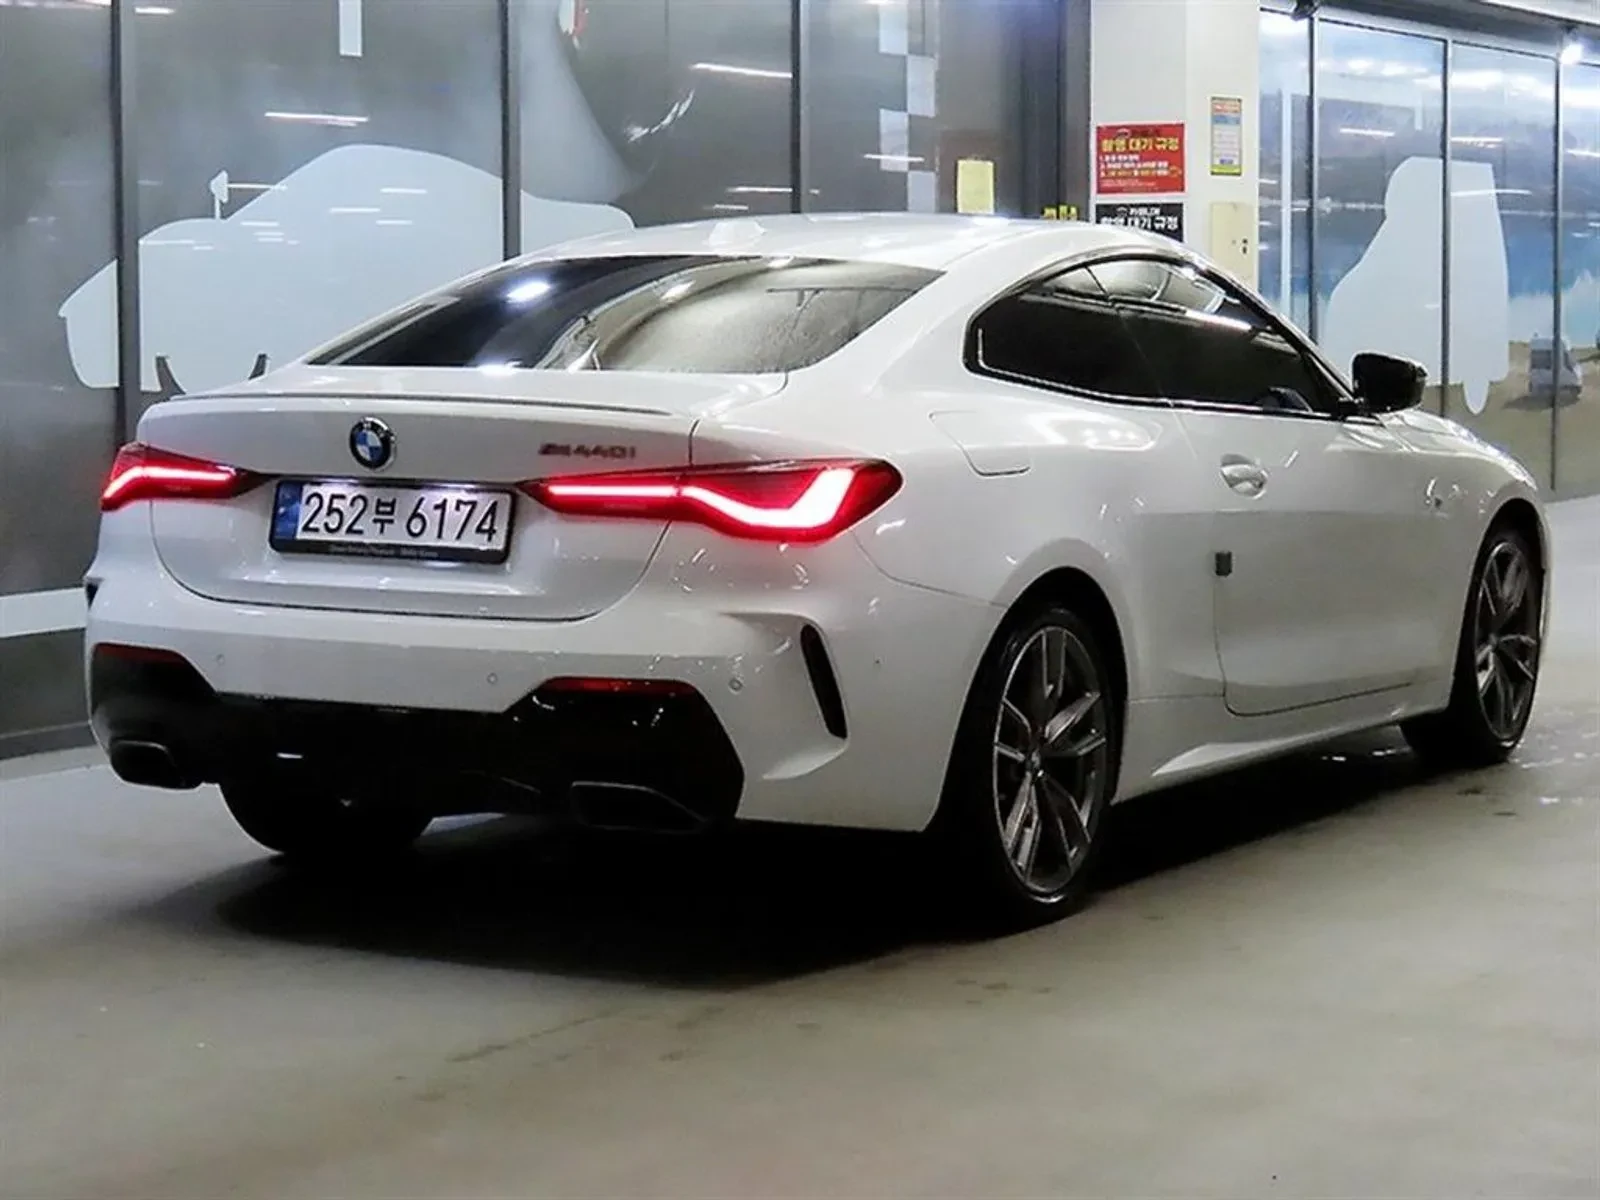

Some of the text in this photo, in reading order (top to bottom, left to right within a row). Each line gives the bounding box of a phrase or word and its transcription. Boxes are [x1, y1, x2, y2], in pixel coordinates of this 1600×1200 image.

[1129, 138, 1153, 151] 대기
[1155, 137, 1179, 151] 규정
[1154, 216, 1178, 231] 규정
[405, 497, 499, 543] 6174
